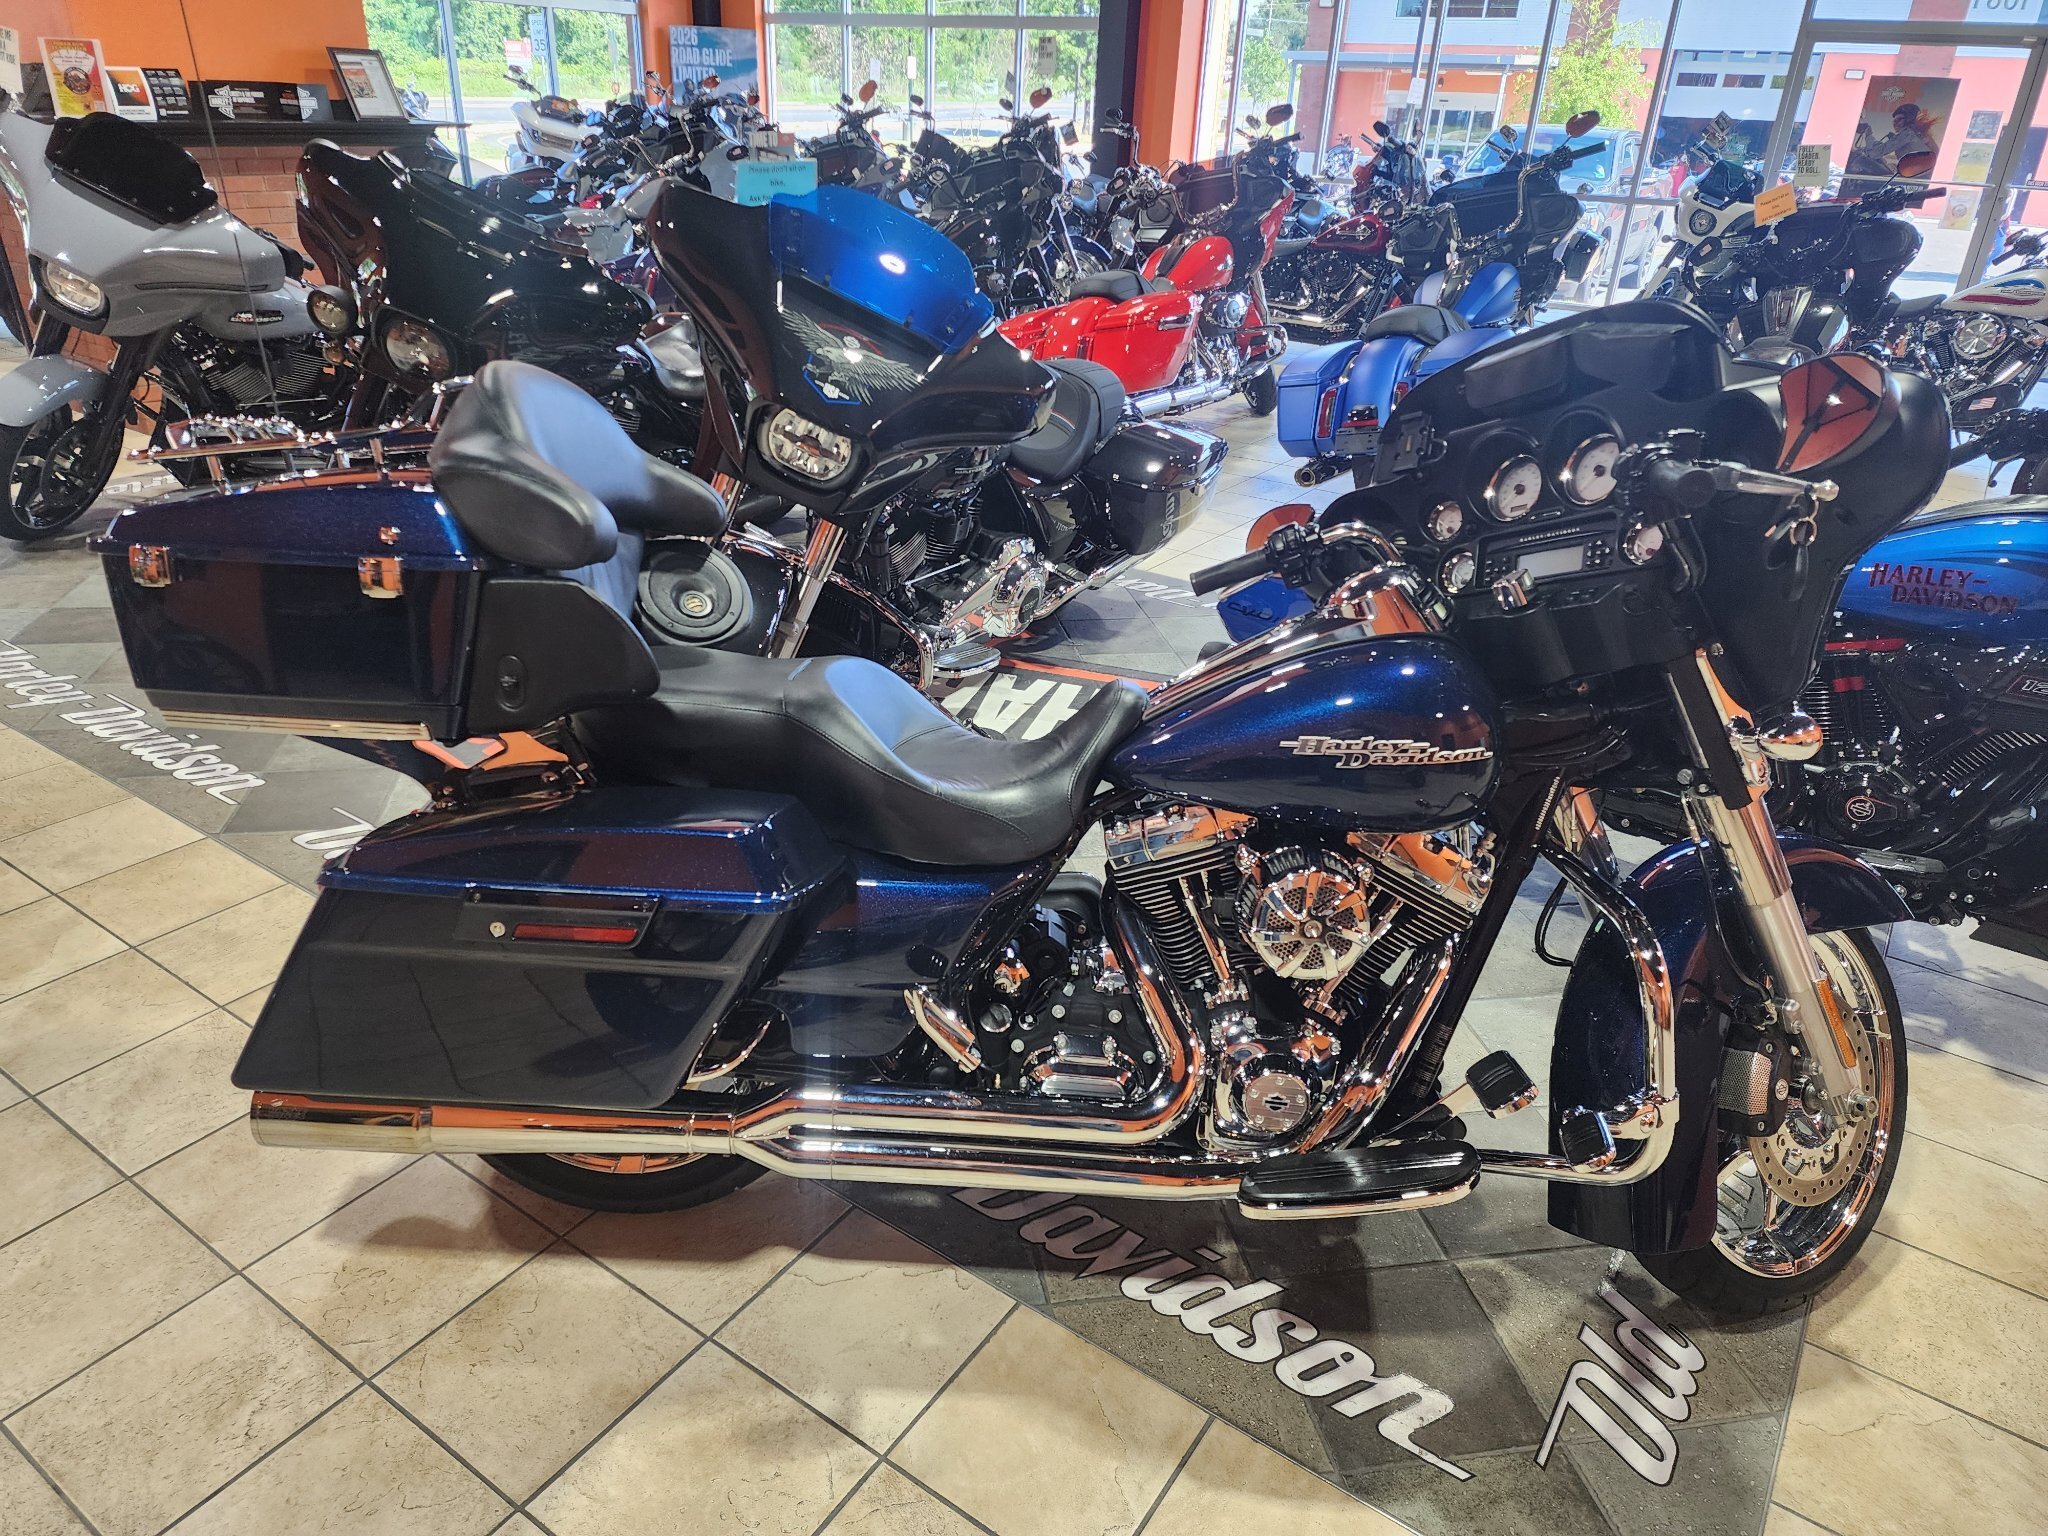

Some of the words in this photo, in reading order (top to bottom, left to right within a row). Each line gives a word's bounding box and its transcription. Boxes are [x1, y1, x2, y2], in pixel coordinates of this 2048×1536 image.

[534, 38, 546, 51] 35
[671, 27, 698, 45] 2026
[671, 46, 699, 64] ROAD
[702, 48, 732, 67] GLIDE
[749, 165, 770, 173] Please
[1891, 584, 2019, 615] DAVIDSON
[1335, 746, 1494, 769] Davidson
[950, 1187, 1475, 1481] Davidson
